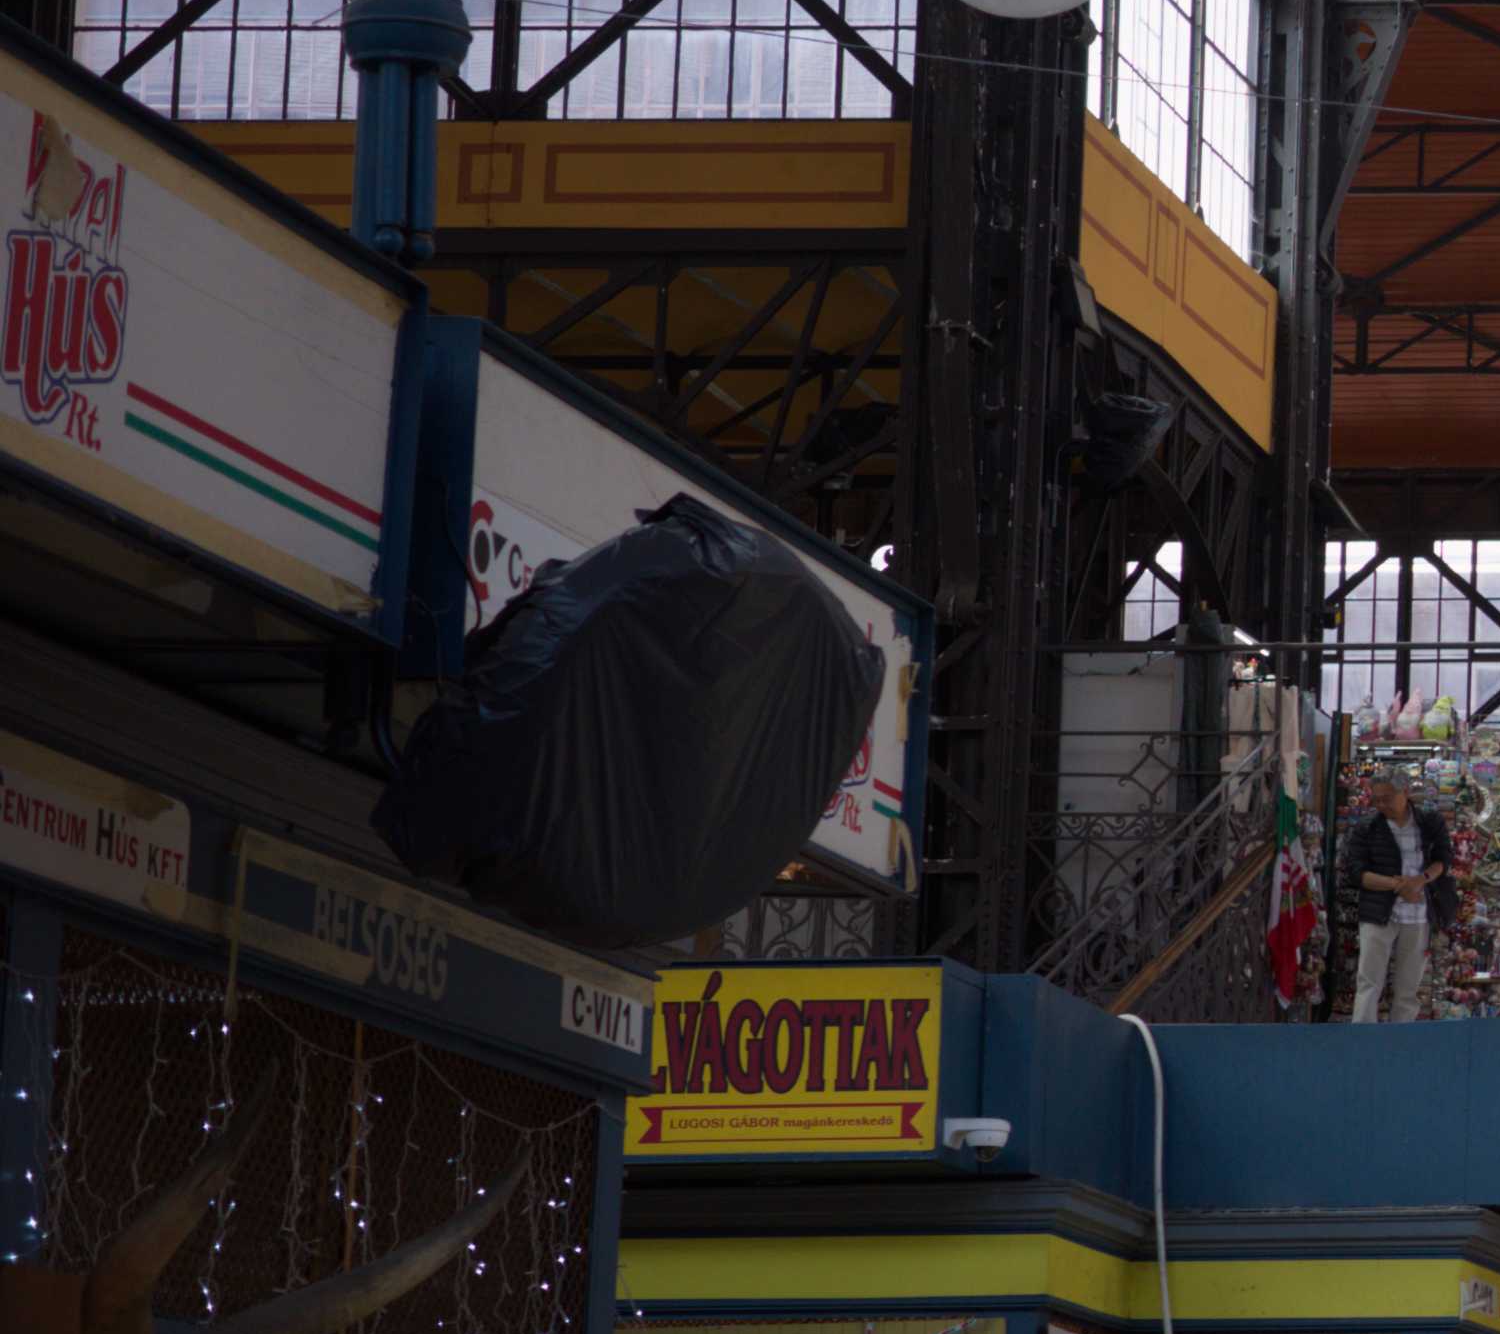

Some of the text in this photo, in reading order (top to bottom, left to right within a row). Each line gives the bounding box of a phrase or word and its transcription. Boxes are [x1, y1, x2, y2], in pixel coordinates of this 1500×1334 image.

[65, 391, 101, 451] Rt.
[843, 792, 863, 834] Rt.
[97, 807, 138, 867] HÚS
[147, 841, 188, 887] KFT.
[570, 985, 636, 1048] C-VI/1.
[650, 970, 930, 1095] VÁGOTTAK
[669, 1117, 724, 1130] LUGOSI
[729, 1114, 779, 1129] GÁBOR
